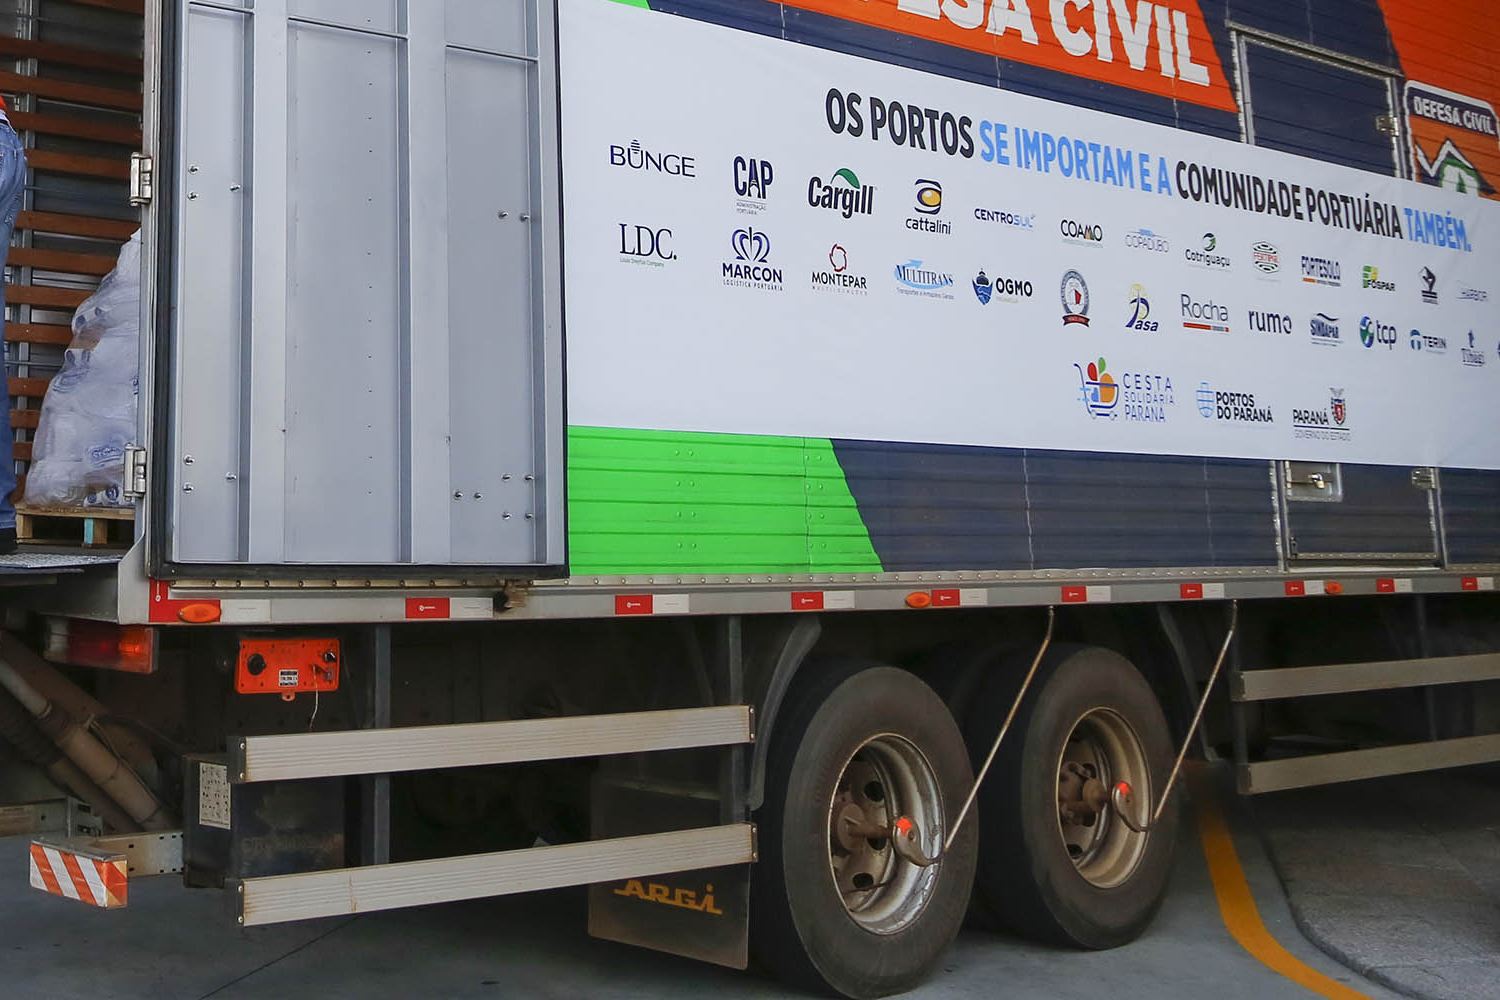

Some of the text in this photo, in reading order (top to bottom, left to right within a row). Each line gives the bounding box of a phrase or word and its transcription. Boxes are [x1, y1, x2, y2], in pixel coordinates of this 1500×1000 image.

[1412, 95, 1496, 135] DEFESA CIVIL
[733, 155, 774, 200] CAP
[825, 87, 1473, 253] OS PORTOS SE IMPORTAM E A COMUNIDADE PORTUÁRIA TAMBÉM.
[807, 175, 875, 219] Cargill
[905, 217, 951, 235] cattalini
[974, 207, 1034, 228] CENTROSUL
[1060, 218, 1103, 242] COAMO
[1185, 248, 1231, 268] Cotriguaçu
[722, 262, 783, 284] MARCON
[811, 271, 868, 290] MONTEPAR
[995, 277, 1033, 298] OGMO
[1180, 293, 1229, 322] Rocha
[1248, 310, 1293, 335] rumo
[1376, 319, 1397, 350] tcp
[1122, 372, 1173, 393] CESTA
[1215, 391, 1256, 407] PORTOS
[1216, 405, 1274, 423] DO PARANÁ
[1292, 408, 1330, 425] PARANÁ
